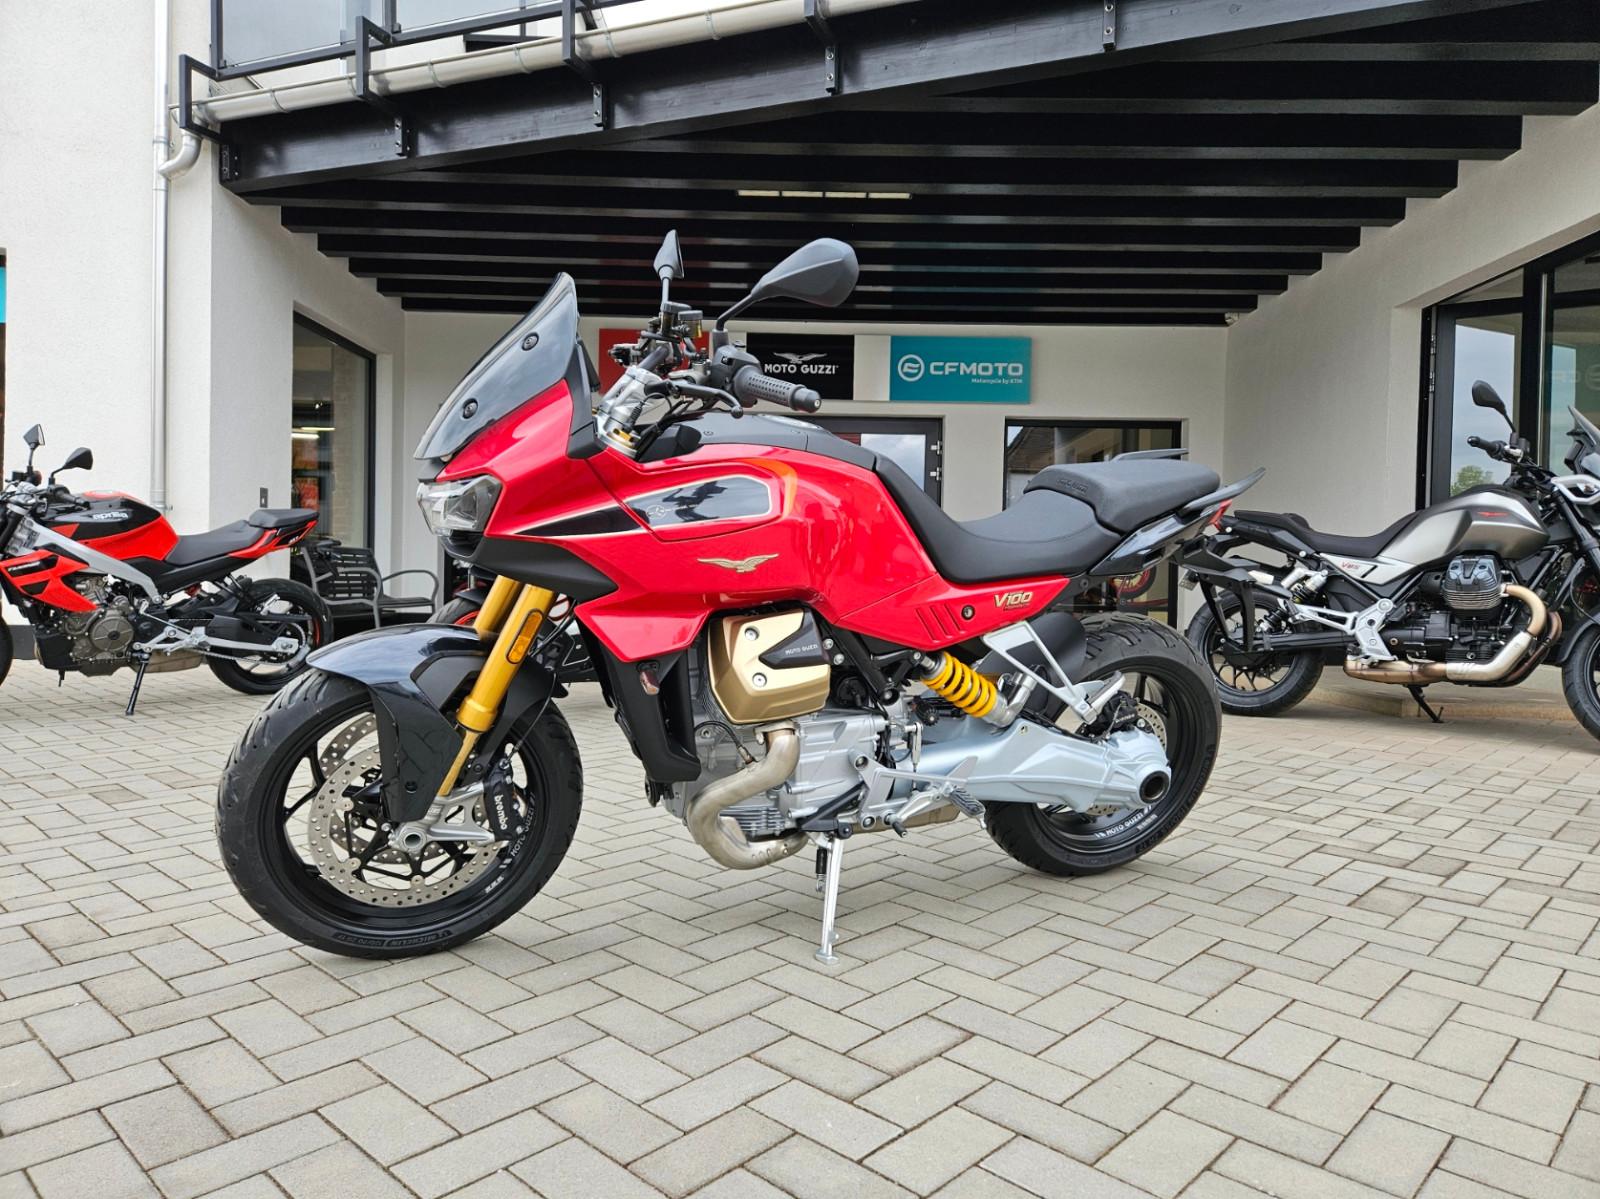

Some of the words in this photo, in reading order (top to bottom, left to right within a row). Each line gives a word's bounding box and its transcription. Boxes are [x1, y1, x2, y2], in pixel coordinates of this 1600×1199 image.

[764, 363, 797, 374] MOTO
[800, 364, 836, 375] GUZZI
[929, 361, 1023, 376] CFMOTO
[93, 511, 129, 520] aprilia
[994, 592, 1033, 608] V100
[494, 794, 509, 831] brembo
[1106, 824, 1124, 836] MOTO
[1124, 812, 1143, 827] GUZZI
